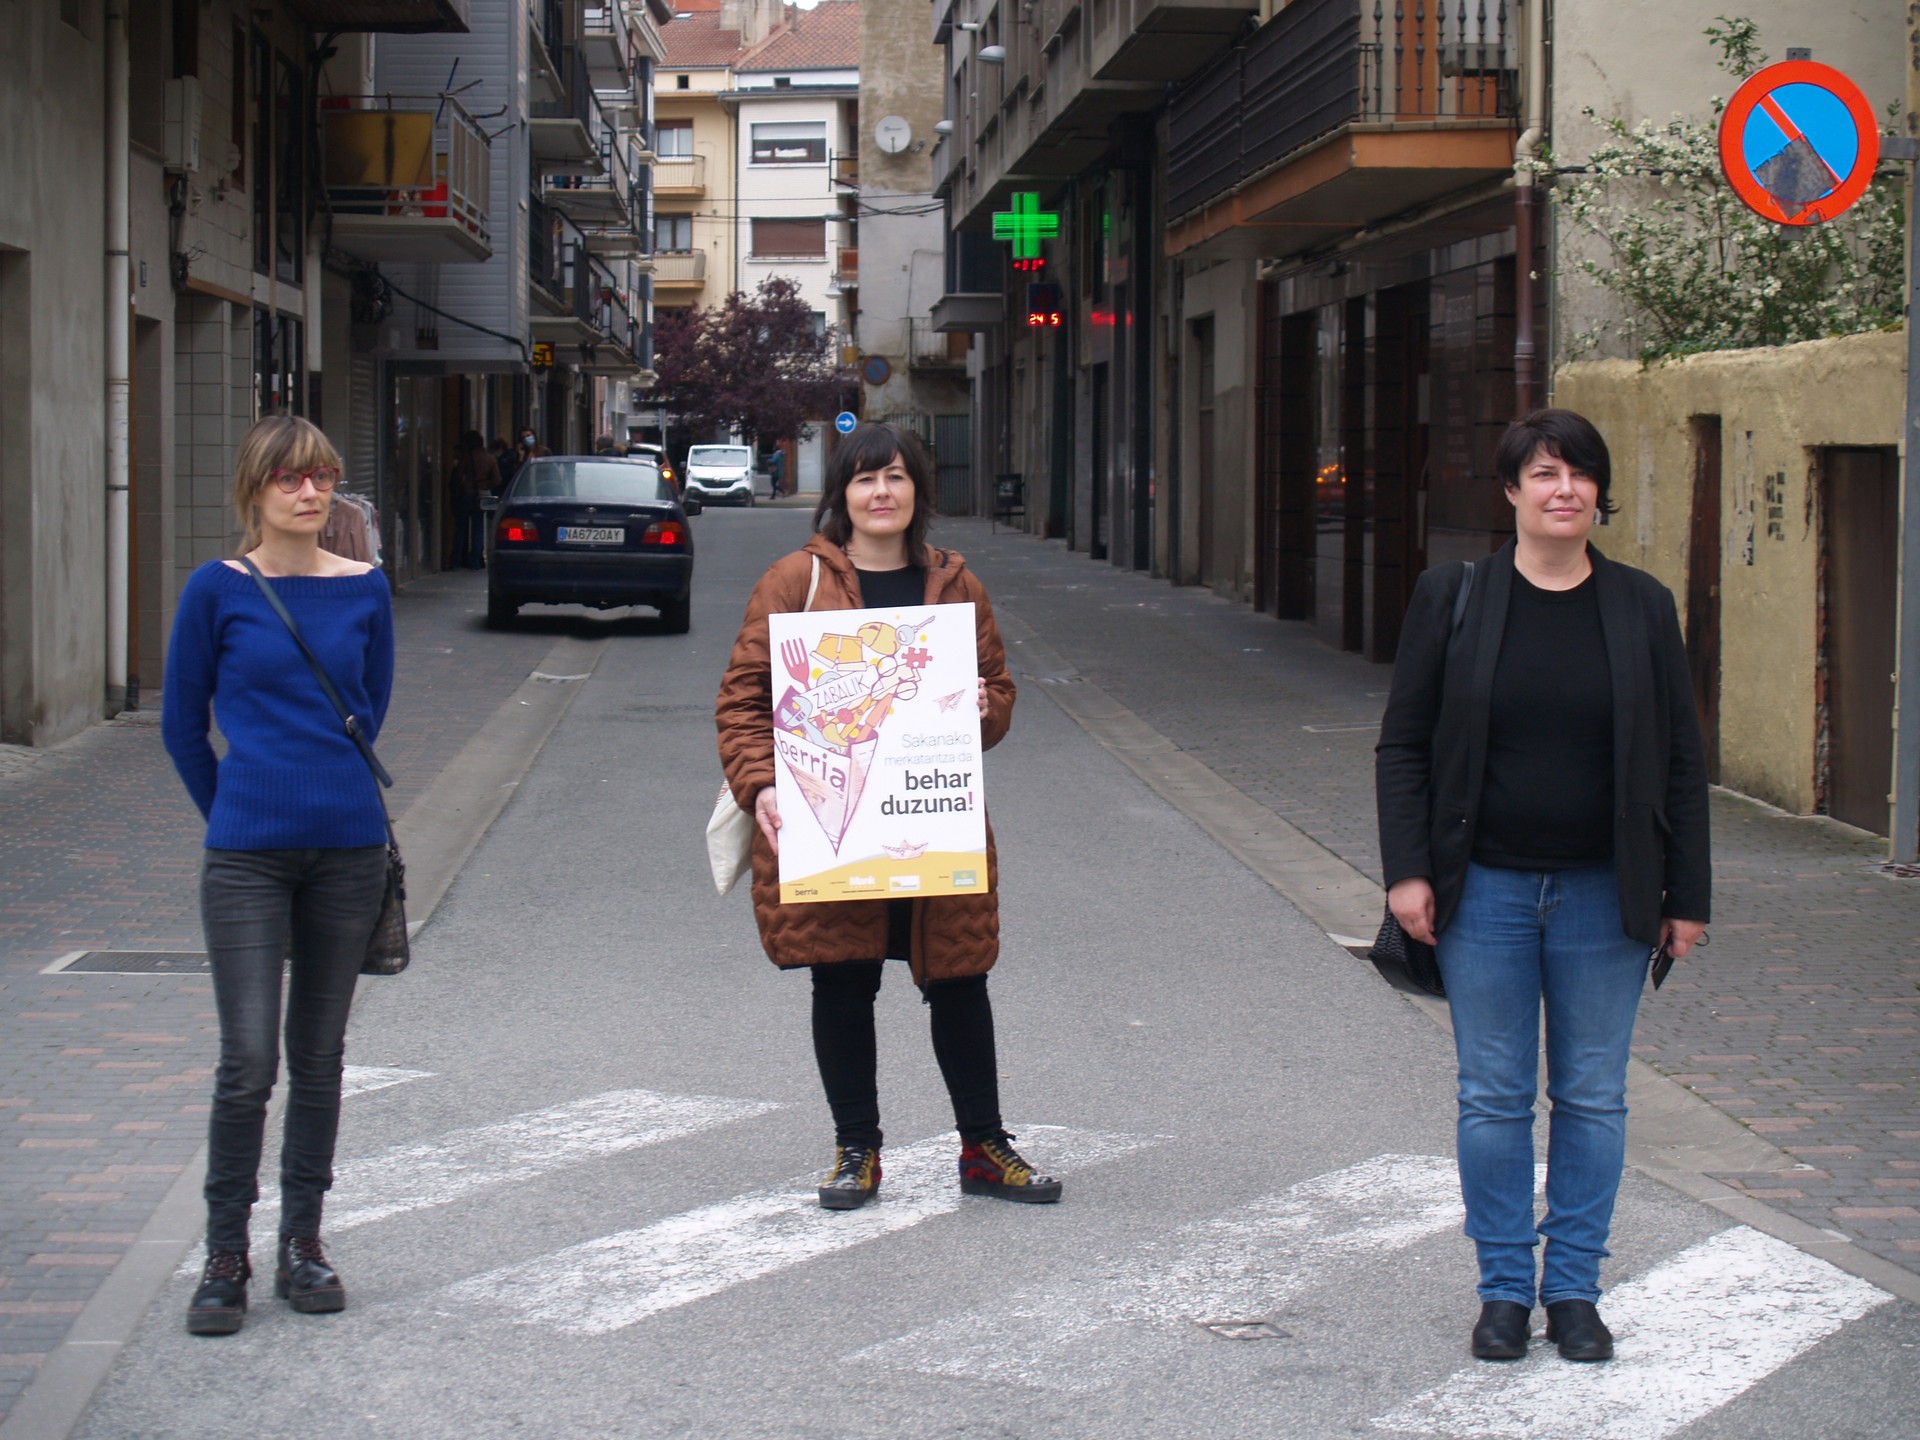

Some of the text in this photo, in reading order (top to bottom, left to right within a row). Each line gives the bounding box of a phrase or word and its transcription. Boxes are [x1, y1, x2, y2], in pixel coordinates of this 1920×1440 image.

[1029, 313, 1059, 325] 24 5
[565, 529, 620, 541] NA6720AY
[813, 674, 870, 709] ZABALIK
[902, 731, 972, 748] Sakanako
[777, 731, 846, 792] berria
[884, 751, 973, 766] merkataritza da
[905, 768, 972, 791] behar
[881, 791, 973, 815] duzuna!
[795, 888, 818, 896] berria
